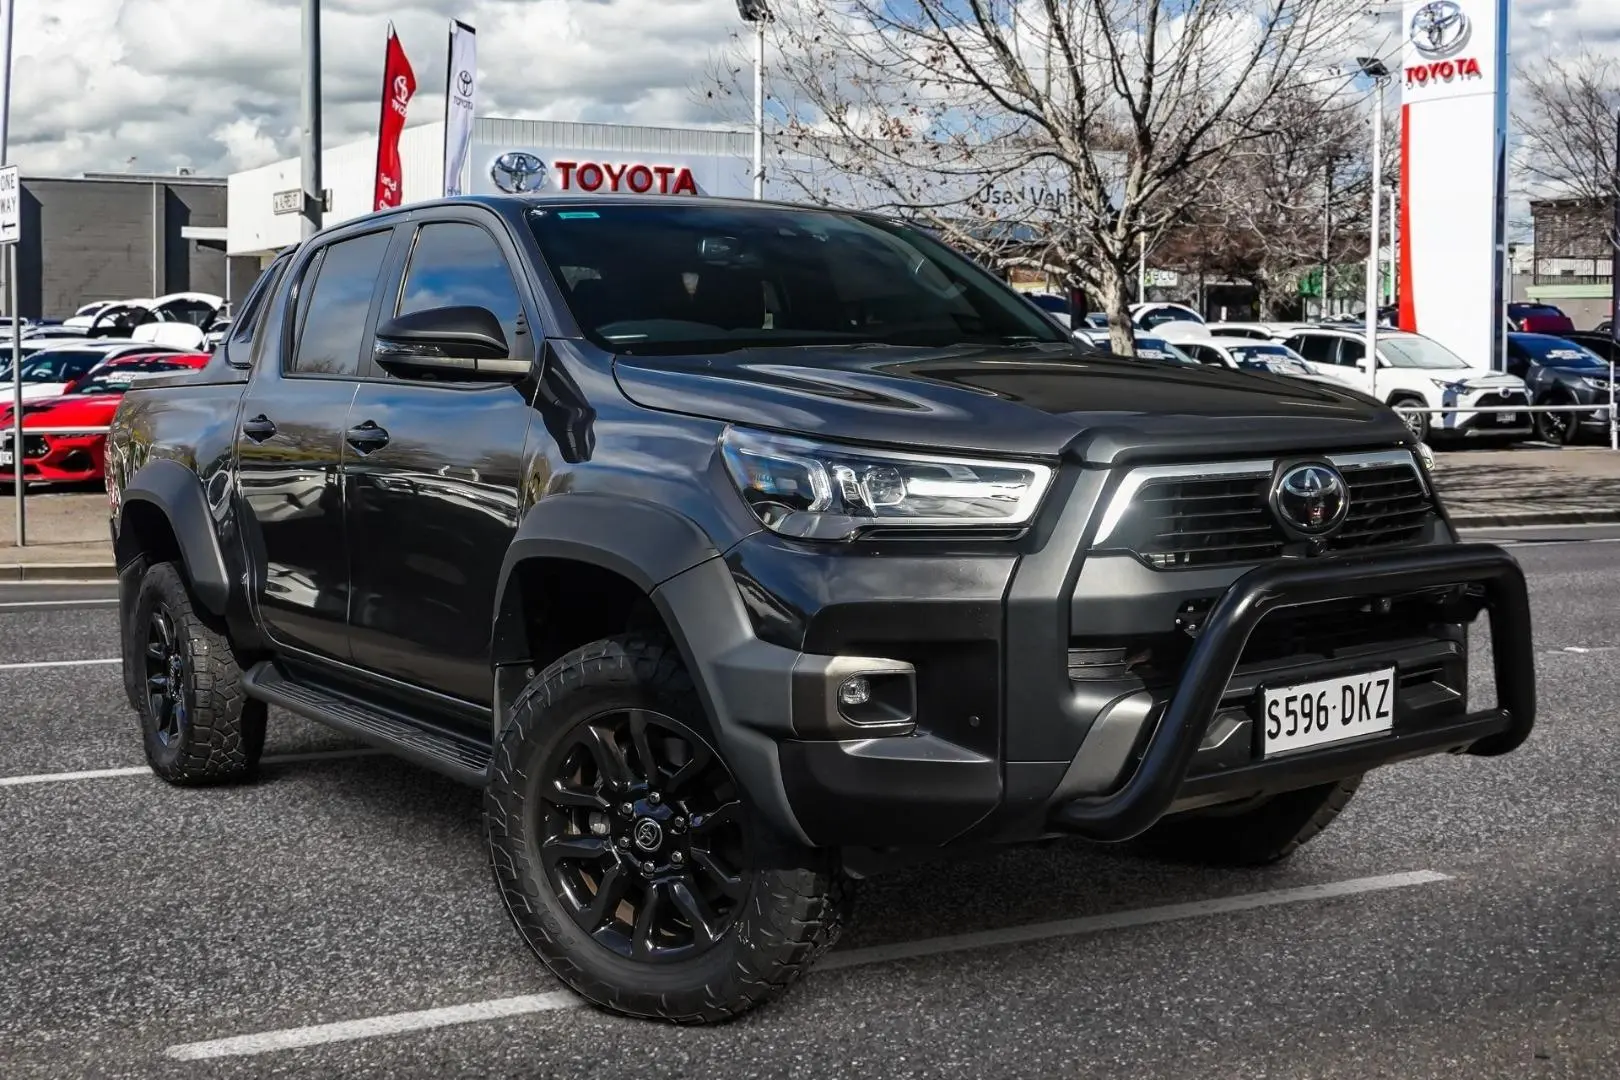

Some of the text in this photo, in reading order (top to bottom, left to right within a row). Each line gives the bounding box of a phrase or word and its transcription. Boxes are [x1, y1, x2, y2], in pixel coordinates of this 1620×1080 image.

[1404, 58, 1481, 83] TOYOTA
[1, 173, 15, 191] ONE
[555, 161, 698, 195] TOYOTA
[978, 184, 1025, 204] Used
[0, 196, 17, 214] WAY
